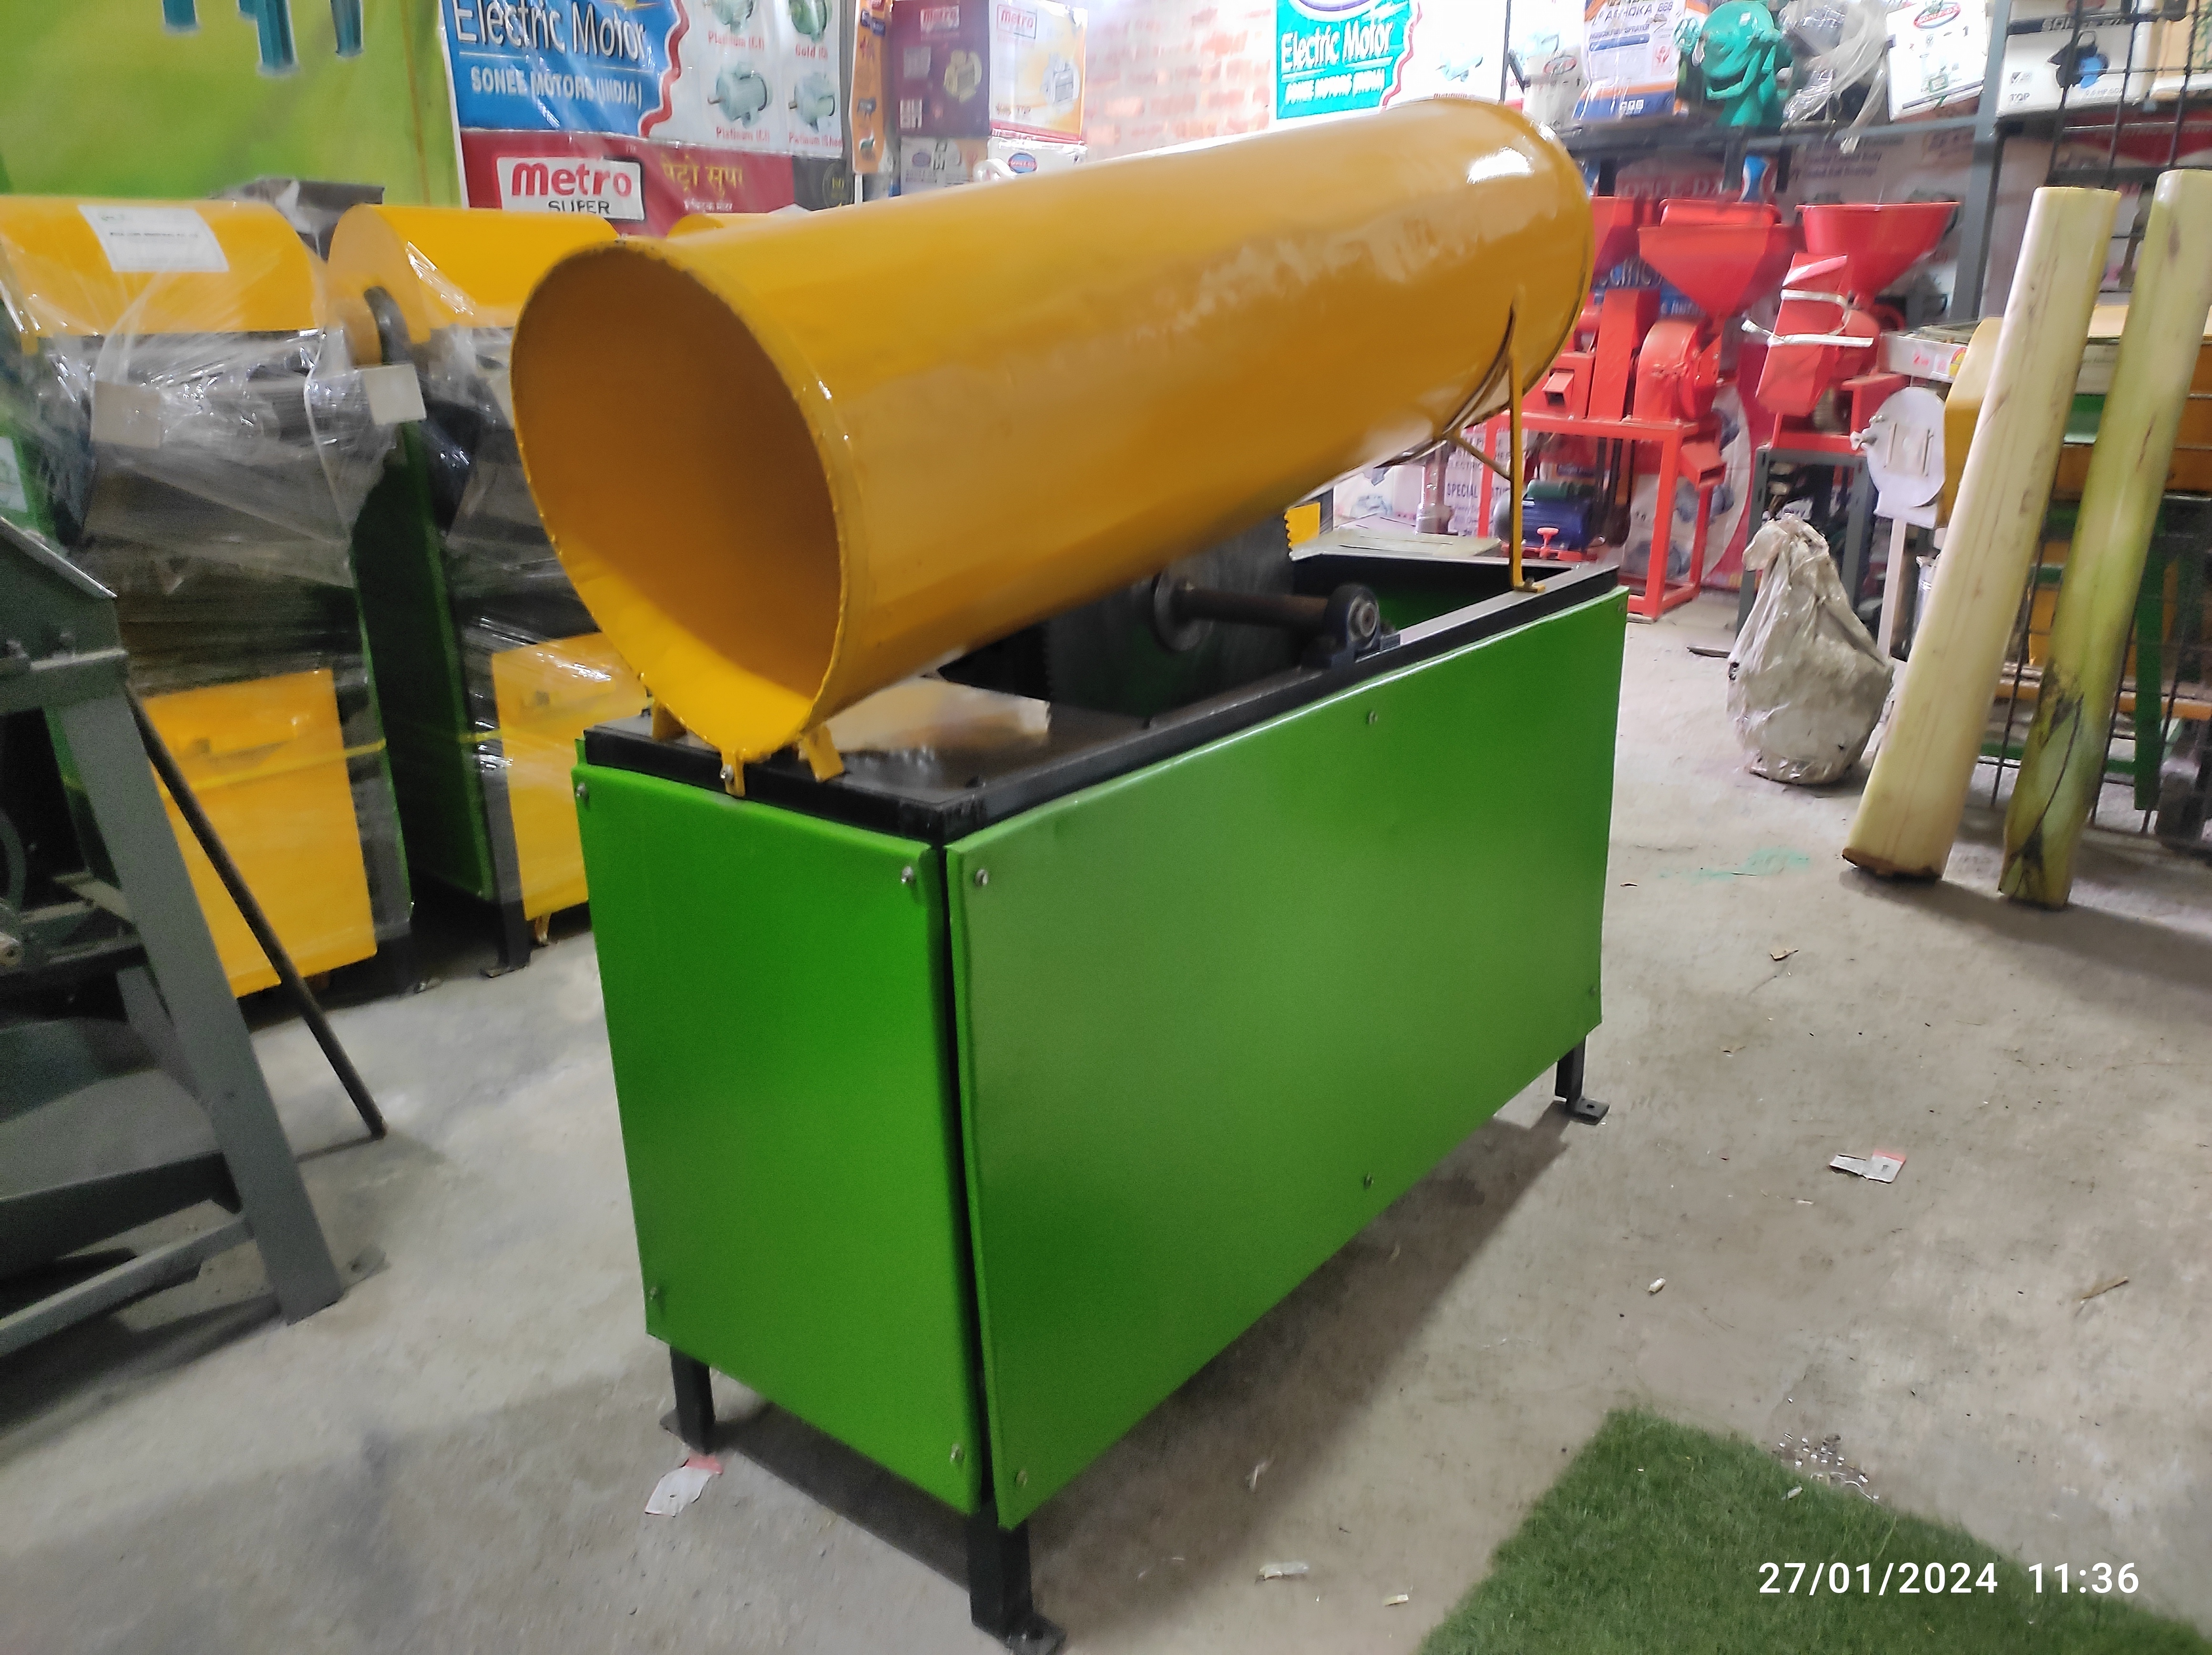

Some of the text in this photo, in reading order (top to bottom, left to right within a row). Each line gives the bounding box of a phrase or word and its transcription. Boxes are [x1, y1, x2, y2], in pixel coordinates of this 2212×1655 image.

[1001, 8, 1034, 29] metro
[454, 0, 645, 61] Electric Motor
[708, 30, 746, 48] Platinum
[795, 44, 816, 59] Gold
[1281, 19, 1393, 73] Electric Motor
[470, 66, 527, 94] SONEE
[530, 71, 596, 100] MOTORS
[716, 127, 753, 142] Platinum
[511, 163, 632, 196] metro
[548, 200, 610, 214] SUPER
[1447, 482, 1478, 498] SPECIAL
